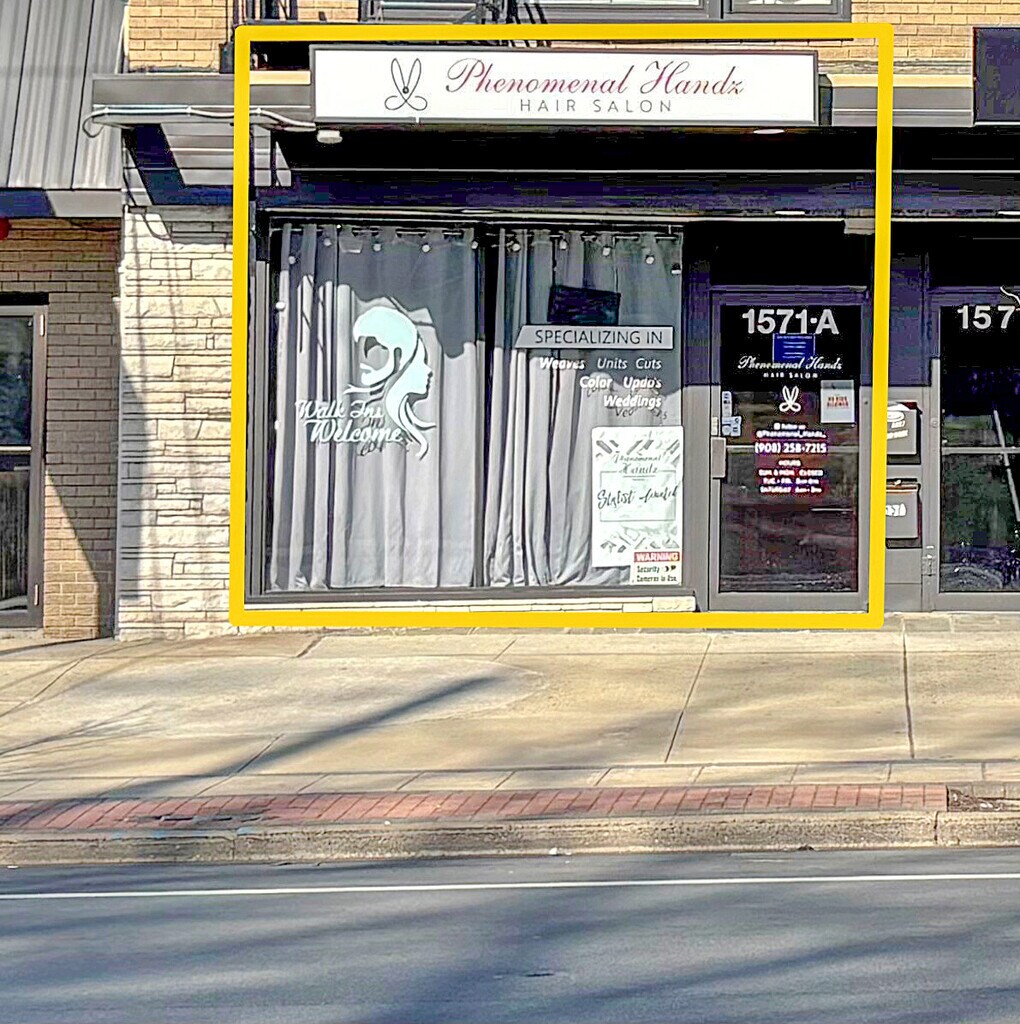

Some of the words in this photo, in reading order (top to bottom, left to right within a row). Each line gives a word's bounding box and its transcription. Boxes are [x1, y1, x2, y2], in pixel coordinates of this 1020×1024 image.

[445, 57, 635, 94] Phenomenal
[639, 60, 745, 95] Handz
[520, 99, 576, 112] HAIR
[592, 99, 671, 113] SALON
[535, 329, 641, 344] SPECIALIZING
[646, 331, 663, 344] IN
[539, 356, 586, 370] Weaves
[597, 358, 628, 370] Units
[635, 358, 662, 370] Cuts
[738, 356, 804, 370] Phenomenal
[579, 376, 613, 389] Color
[623, 376, 662, 391] Updo's
[295, 399, 346, 419] Walk
[603, 394, 662, 410] Weddings
[303, 419, 404, 443] Welcome
[636, 551, 680, 562] WARNING
